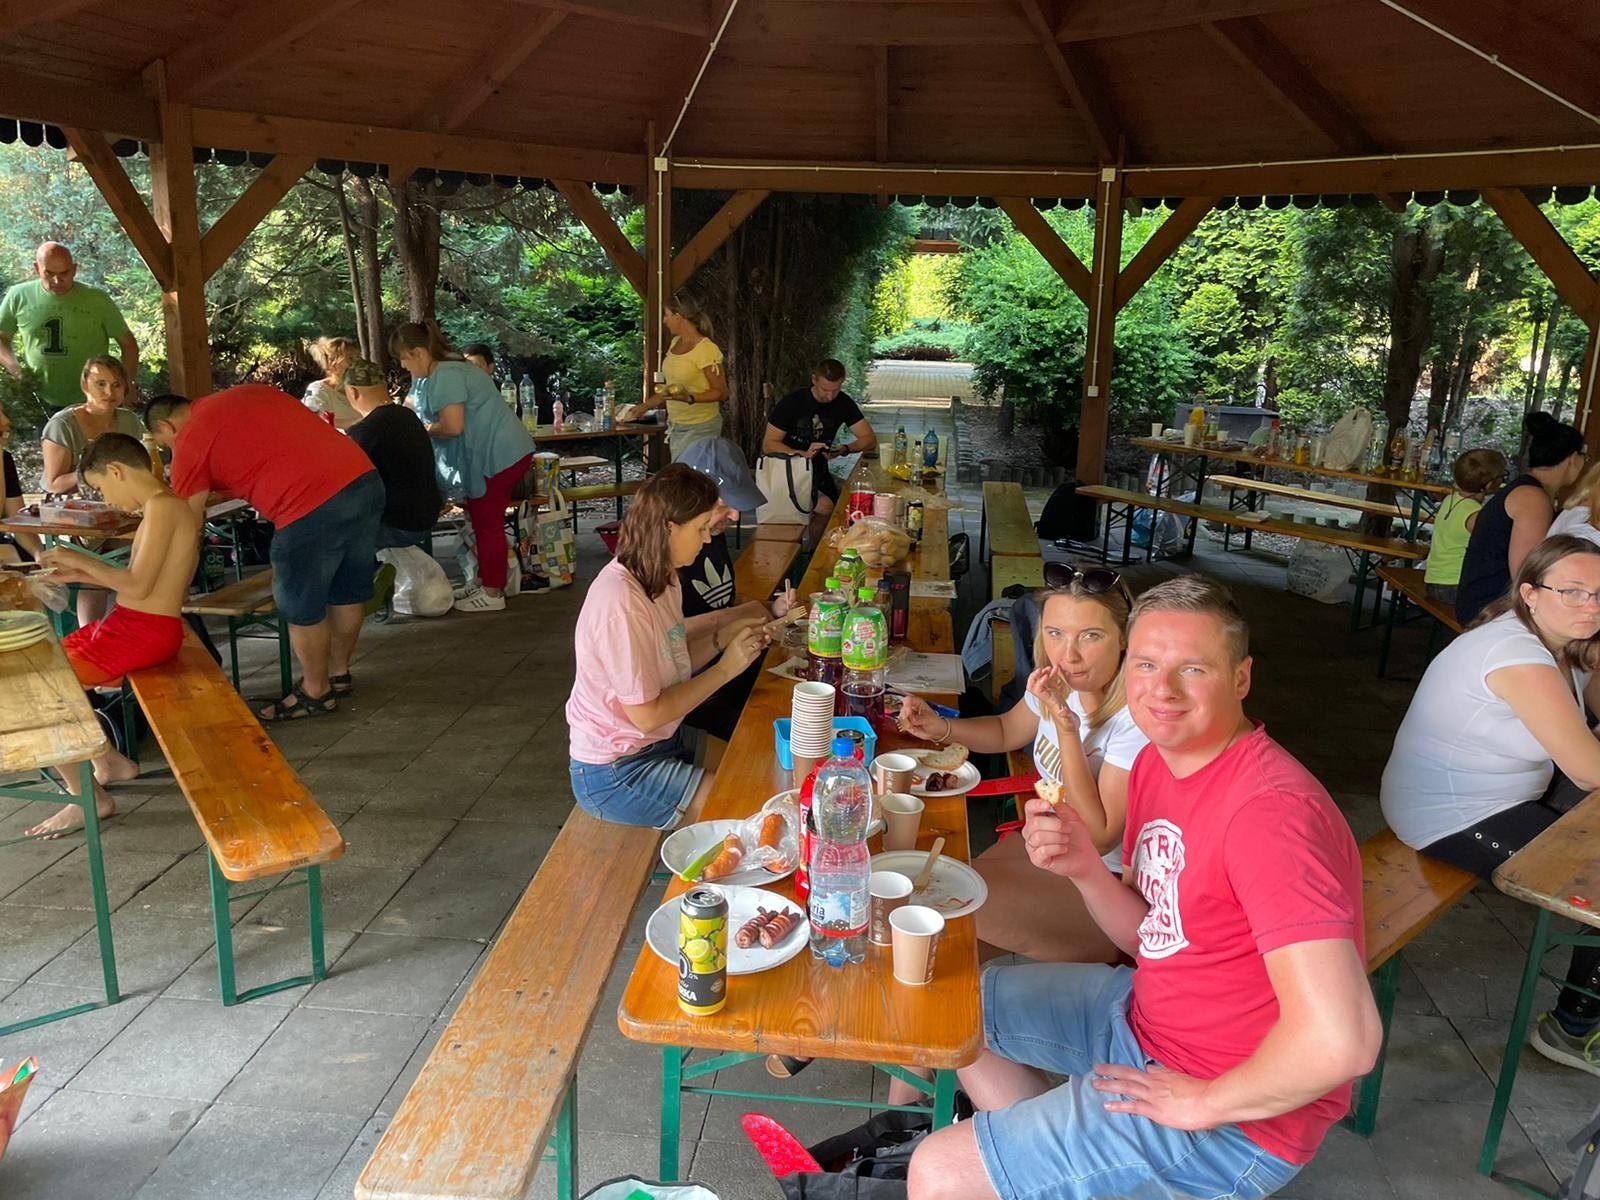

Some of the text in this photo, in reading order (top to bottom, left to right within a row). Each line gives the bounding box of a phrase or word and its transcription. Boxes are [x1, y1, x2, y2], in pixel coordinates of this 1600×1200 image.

[42, 317, 67, 355] 1
[1035, 734, 1062, 782] PUM
[812, 903, 825, 916] ria
